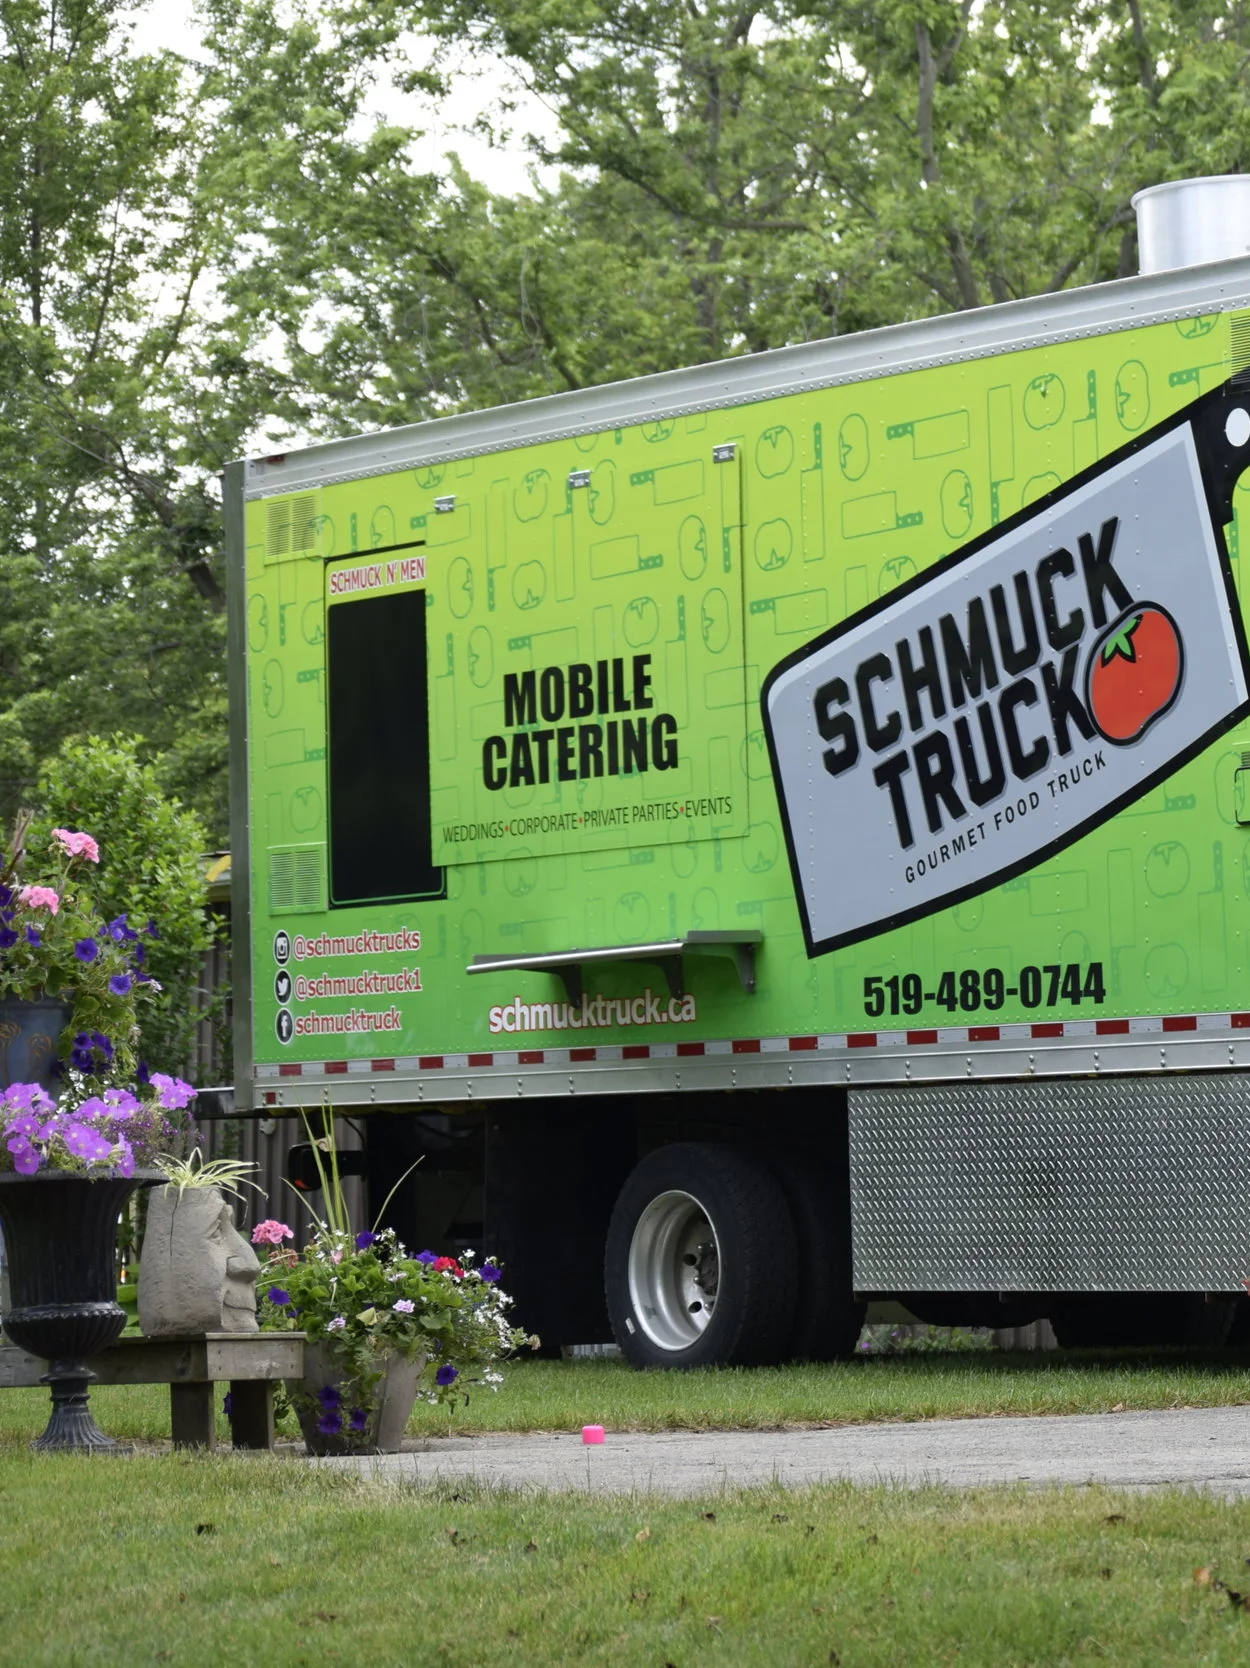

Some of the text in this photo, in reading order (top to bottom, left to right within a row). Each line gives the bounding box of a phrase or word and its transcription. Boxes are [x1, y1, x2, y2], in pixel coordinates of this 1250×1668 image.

[330, 564, 382, 595] SCHMUCK
[400, 556, 425, 583] MEN
[813, 516, 1135, 778] SCHMUCK
[503, 653, 654, 728] MOBILE
[482, 713, 679, 791] CATERING
[873, 643, 1100, 850] TRUCK
[632, 801, 680, 824] PARTIES
[685, 796, 733, 818] EVENTS
[905, 750, 1107, 883] GOURMET FOOD TRUCK
[294, 926, 421, 961] @schmucktrucks
[295, 967, 423, 1001] @schmucktruck1
[862, 961, 1106, 1018] 519-489-0744
[295, 1005, 402, 1035] schmucktruck
[489, 988, 697, 1034] schmucktruck.ca
